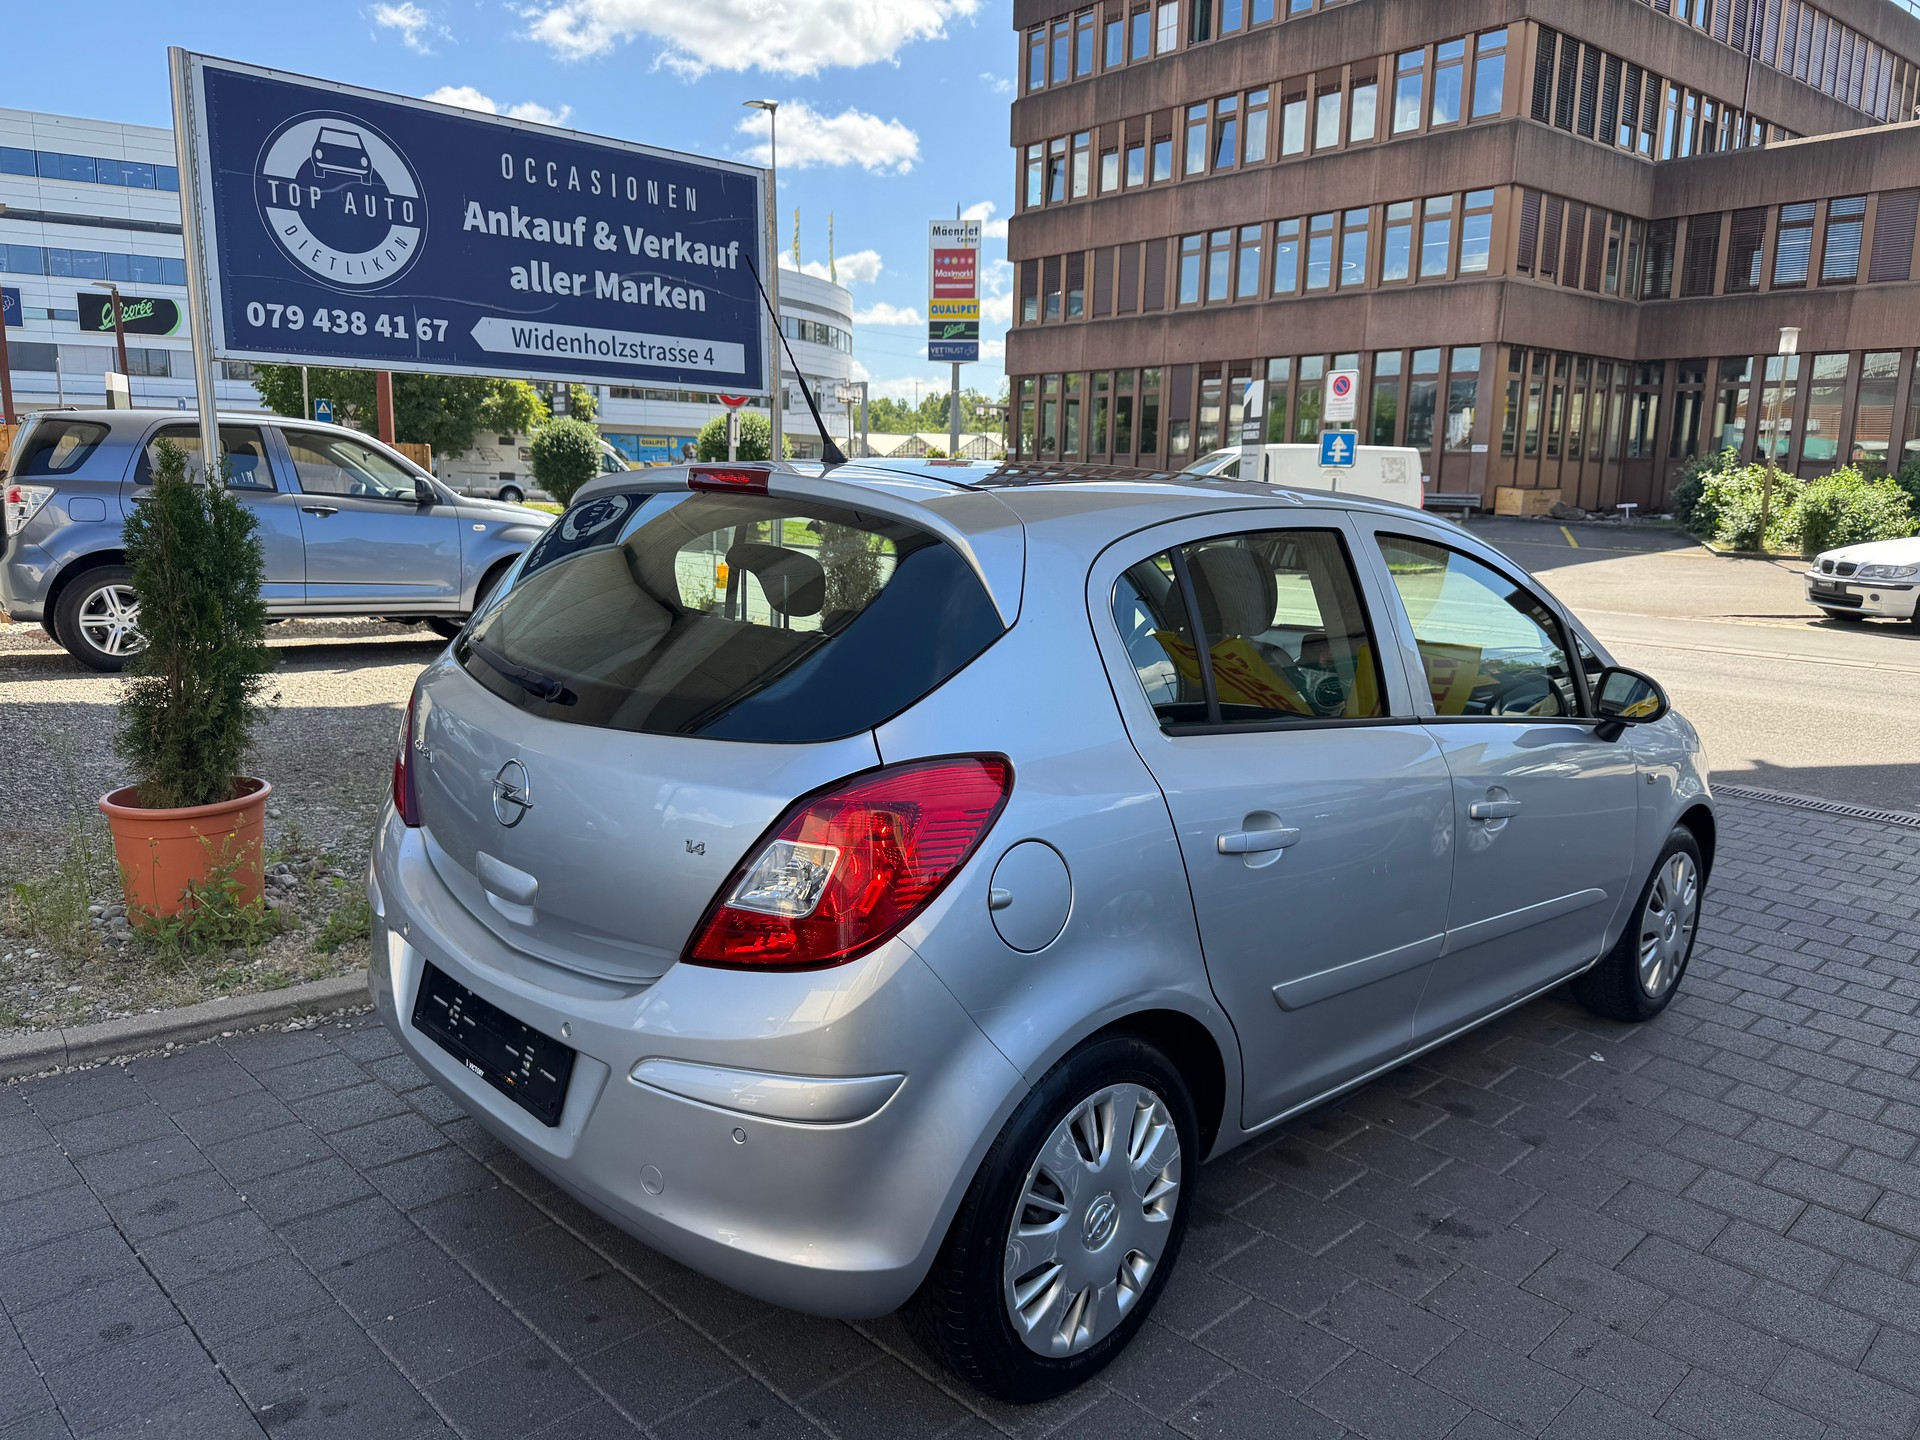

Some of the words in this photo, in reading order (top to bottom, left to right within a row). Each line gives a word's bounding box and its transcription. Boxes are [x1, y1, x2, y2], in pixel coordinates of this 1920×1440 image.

[268, 179, 321, 209] TOP
[344, 192, 414, 223] AUTO
[501, 153, 697, 212] OCCASIONEN
[284, 225, 408, 275] DIETLIKON
[463, 201, 587, 247] Ankauf
[593, 220, 618, 252] &
[623, 225, 739, 270] Verkauf
[510, 260, 587, 296] aller
[595, 270, 706, 312] Marken
[931, 304, 978, 315] QUALIPET
[246, 301, 305, 331] 079
[312, 308, 368, 336] 438
[374, 313, 410, 340] 41
[416, 317, 449, 342] 67
[511, 326, 699, 364] Widenholzstrasse
[703, 347, 715, 365] 4
